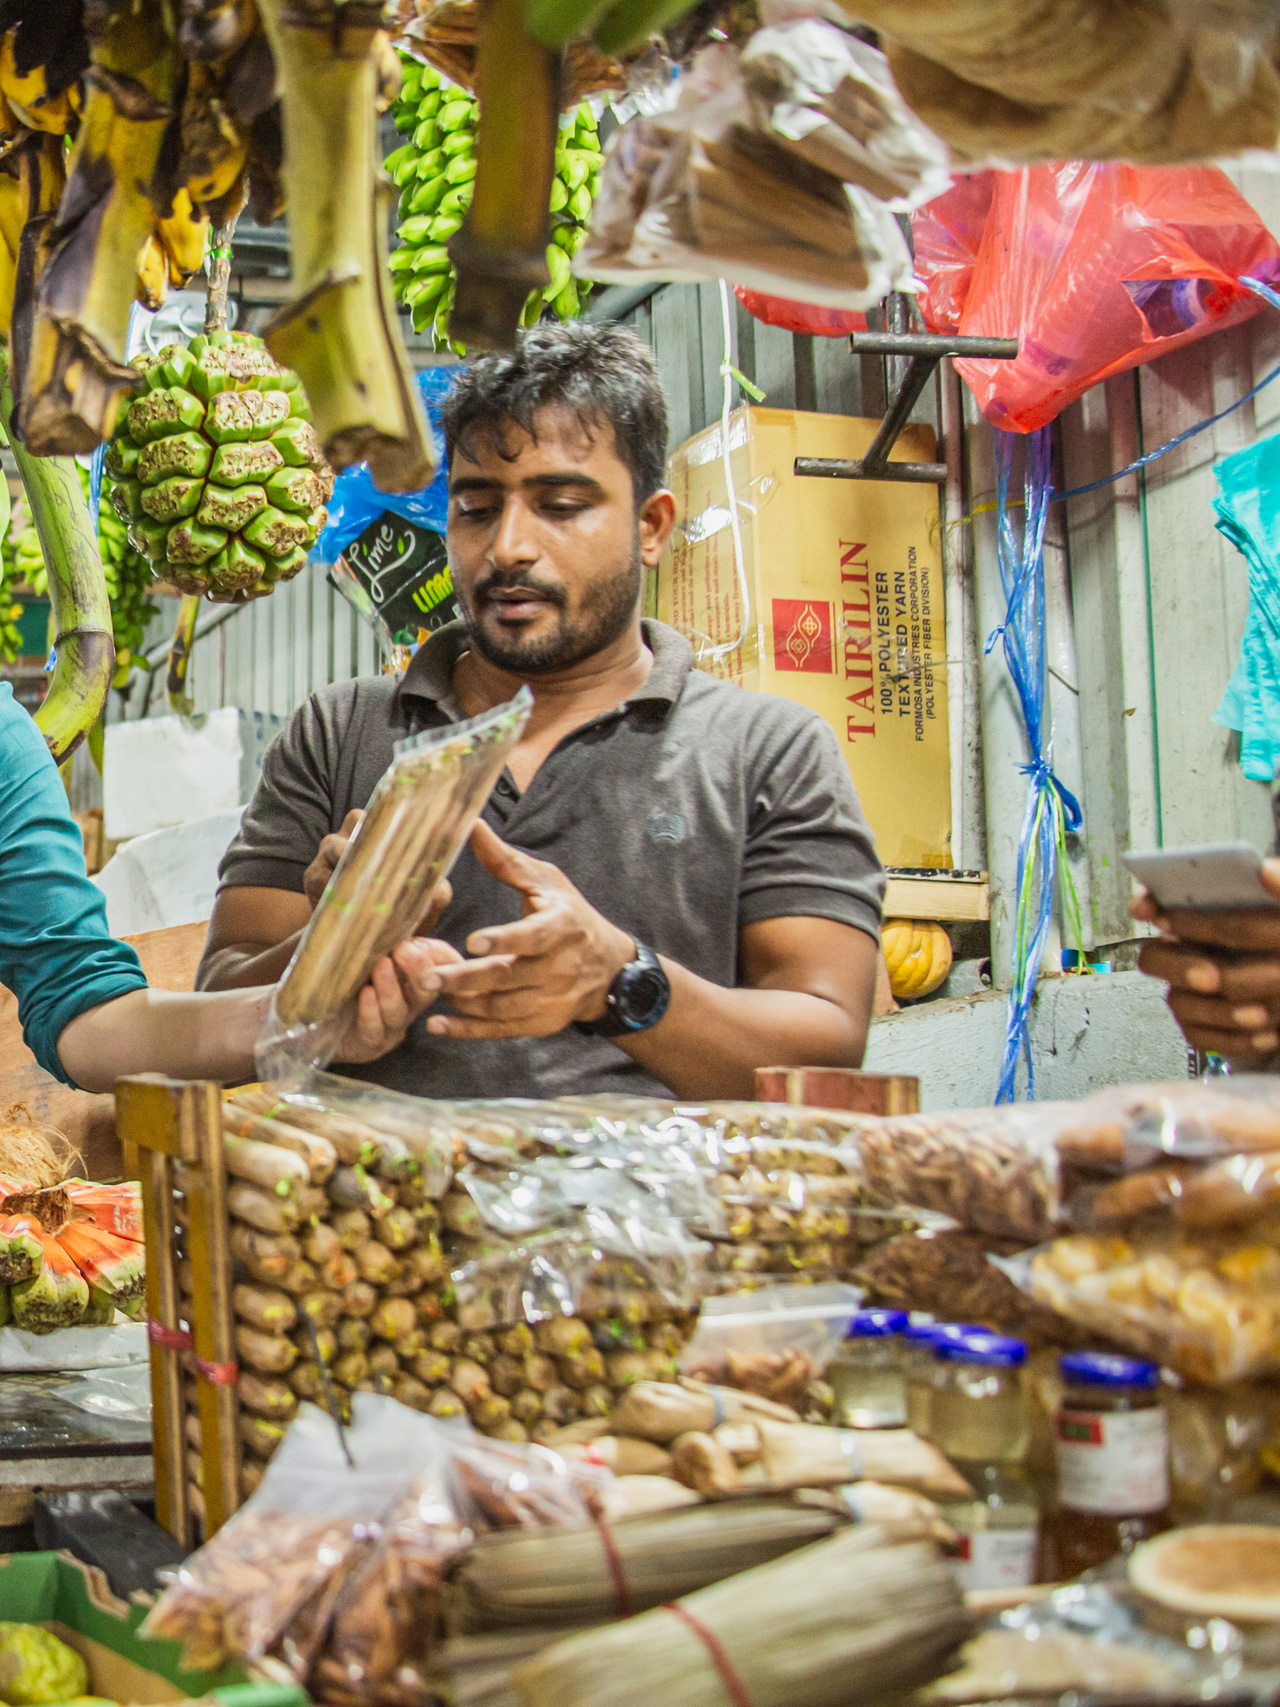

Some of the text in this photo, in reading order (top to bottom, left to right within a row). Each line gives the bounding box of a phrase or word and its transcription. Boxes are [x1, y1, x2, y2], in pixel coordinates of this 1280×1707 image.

[349, 524, 416, 604] Lime
[894, 571, 907, 618] YARN
[838, 539, 876, 743] TAIRILIN
[875, 572, 893, 715] 100% POLYESTER
[907, 546, 924, 742] FORMOSA INDUSTRIES CORPORATION
[920, 567, 936, 720] (POLYESTER FIBER DIVISION)
